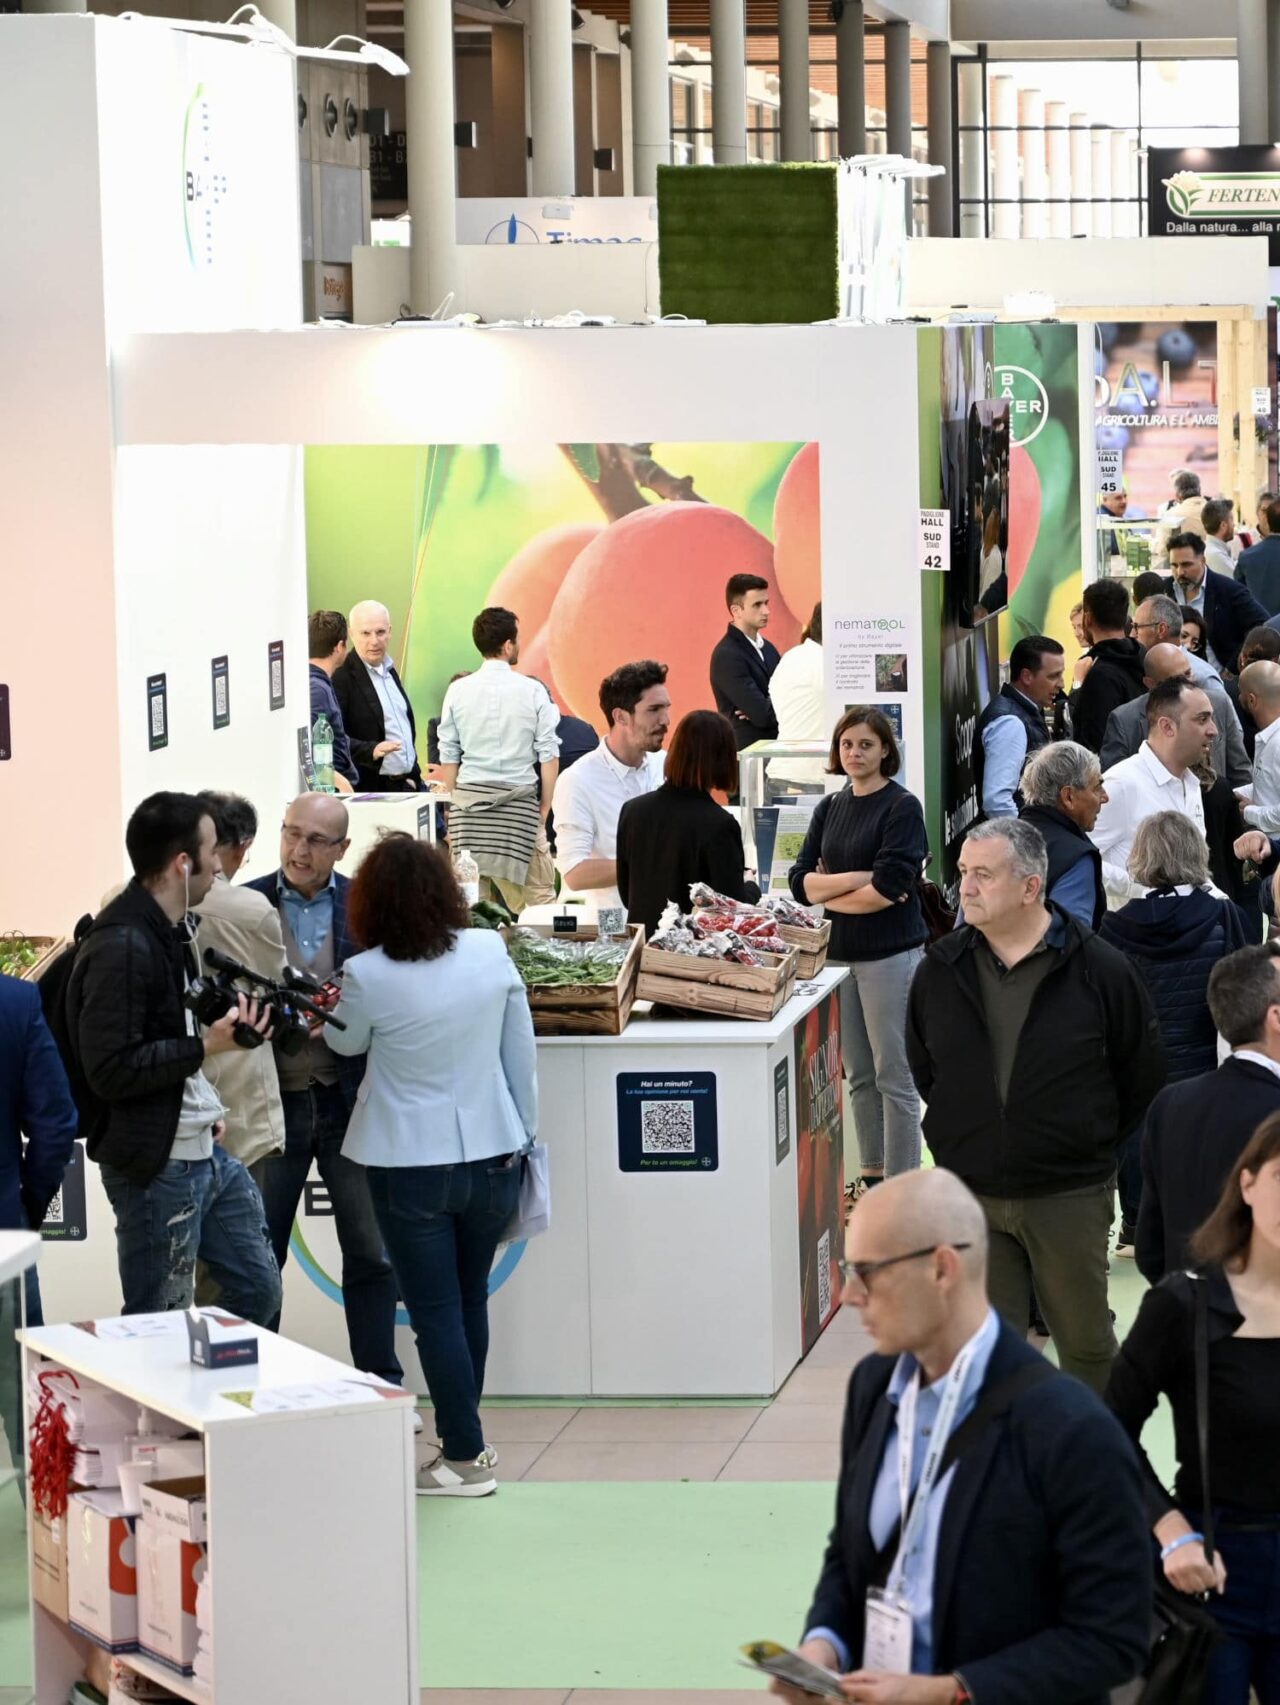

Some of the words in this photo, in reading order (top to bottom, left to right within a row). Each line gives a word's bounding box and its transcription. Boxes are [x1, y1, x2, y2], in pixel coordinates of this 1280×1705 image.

[1166, 222, 1197, 233] Dalla
[1200, 222, 1249, 233] natura...
[1252, 221, 1273, 232] alla
[1096, 414, 1168, 426] AGRICOLTURA
[1100, 482, 1117, 492] 45
[921, 518, 944, 527] HALL
[923, 533, 942, 541] SUD
[924, 555, 942, 568] 42
[664, 1080, 693, 1088] minuto?
